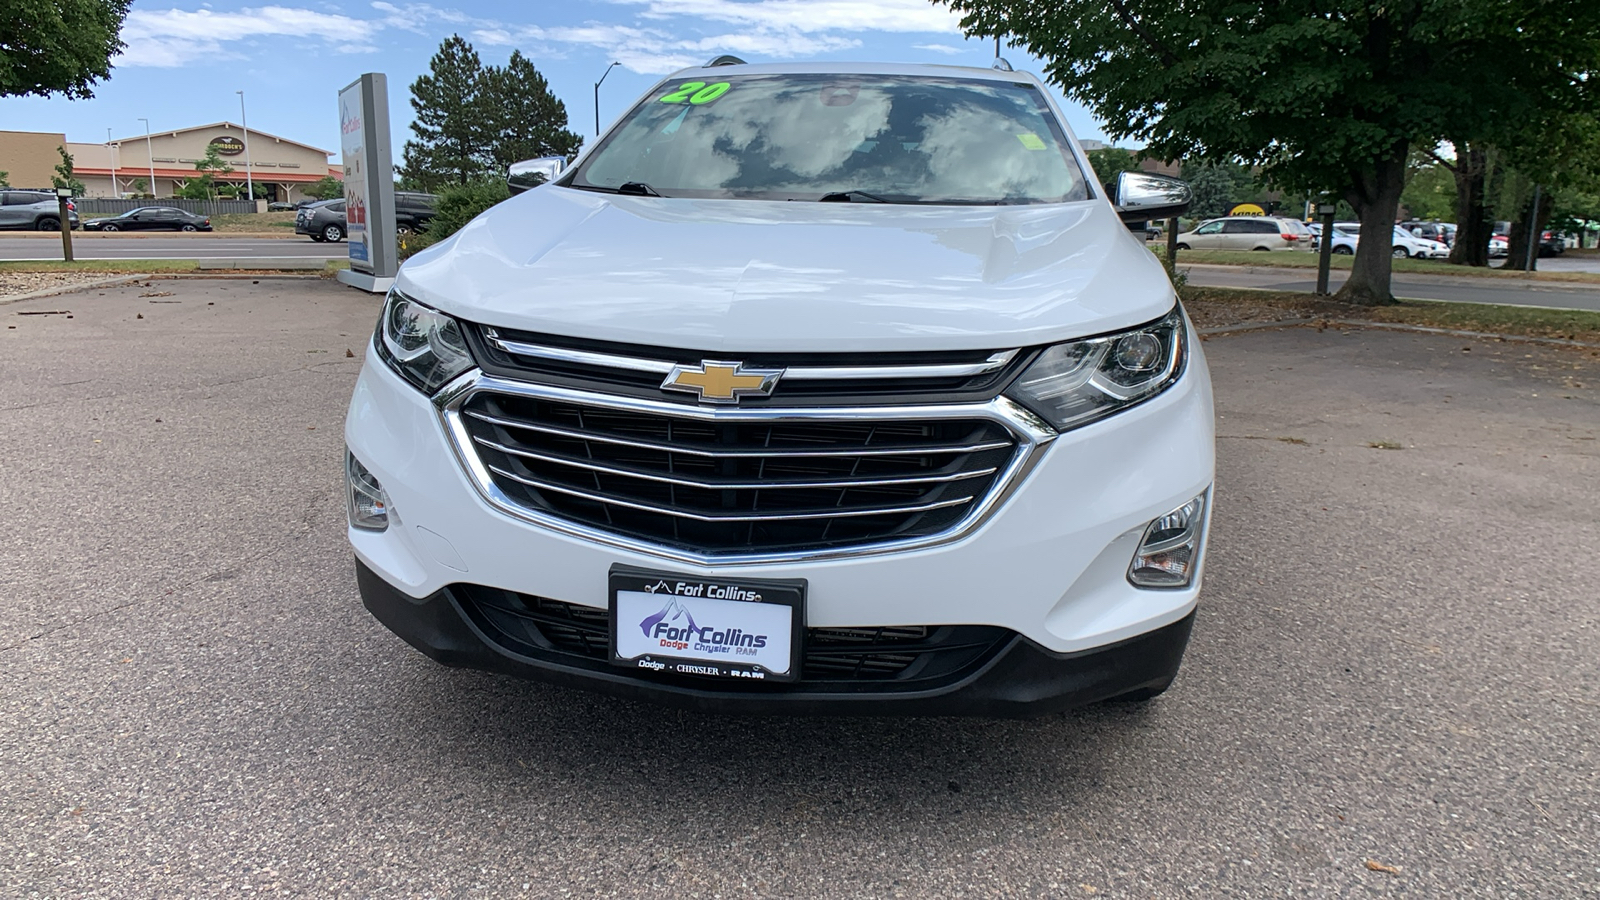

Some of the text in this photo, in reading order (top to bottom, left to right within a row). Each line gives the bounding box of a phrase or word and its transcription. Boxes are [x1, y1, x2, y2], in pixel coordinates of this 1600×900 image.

[660, 81, 731, 105] 20
[675, 582, 756, 601] Fort Collins
[654, 622, 767, 648] Fort Collins
[660, 639, 758, 656] Dodge Chrysler RAM
[638, 659, 765, 679] Dodge CHRYSLER RAM
